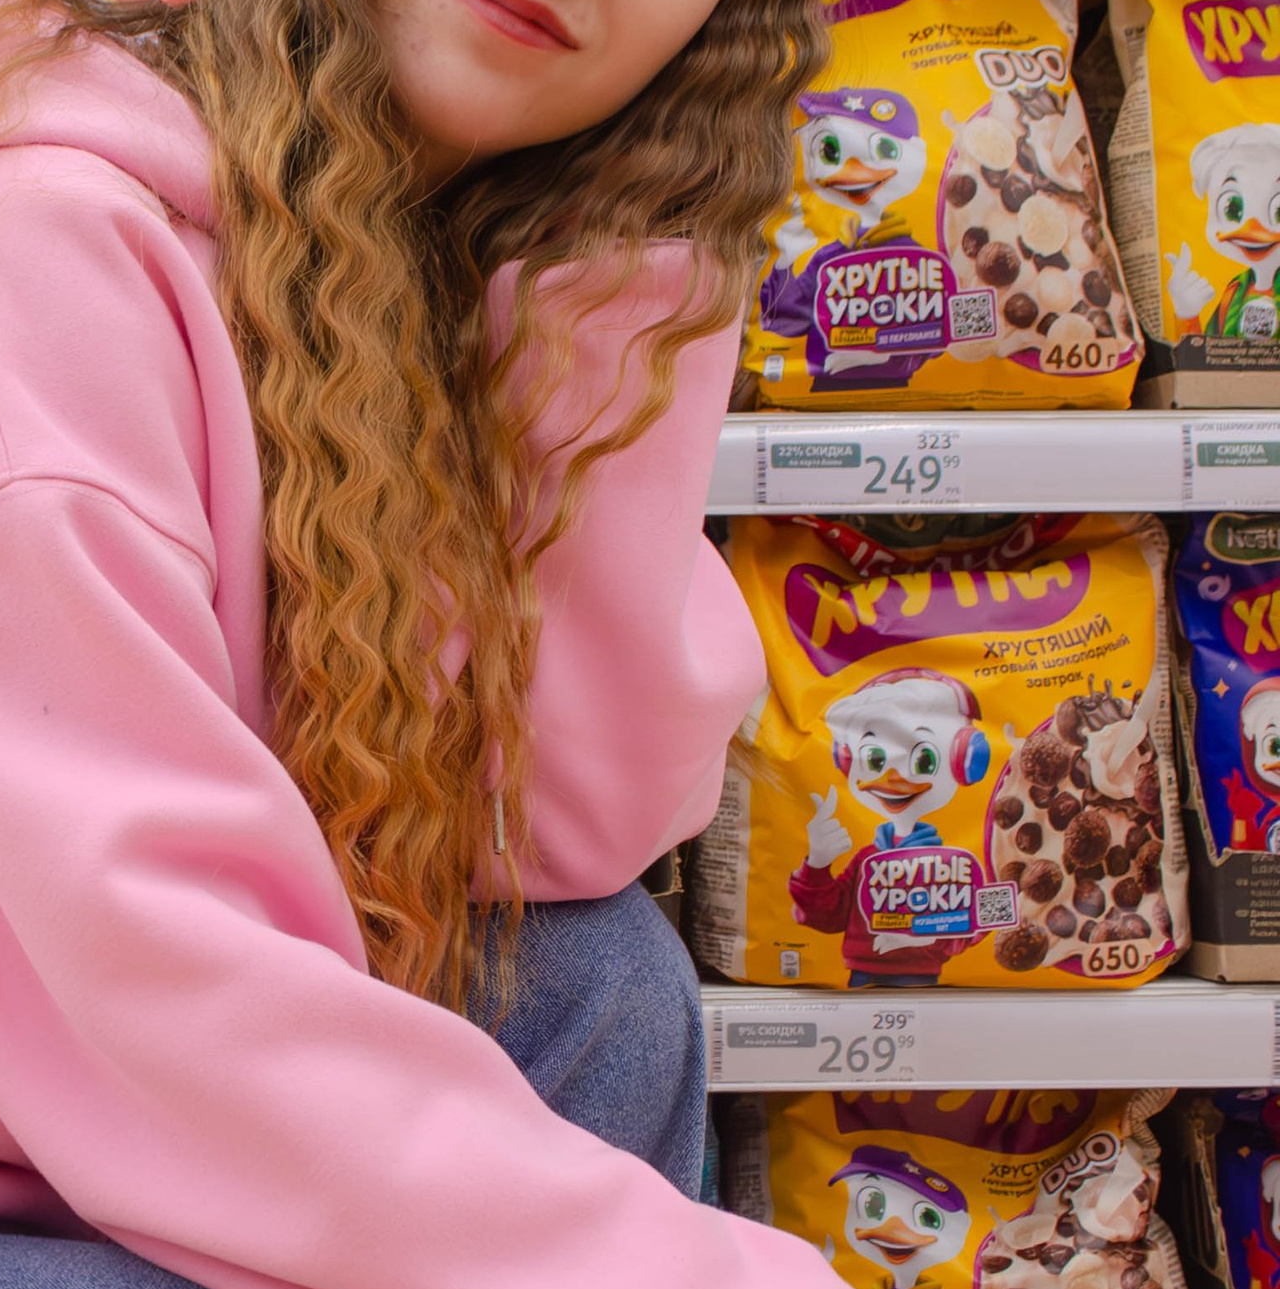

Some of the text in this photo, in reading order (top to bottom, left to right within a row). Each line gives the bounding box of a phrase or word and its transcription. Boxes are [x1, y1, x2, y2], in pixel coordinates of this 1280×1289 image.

[980, 49, 1066, 86] DUO
[825, 258, 943, 297] ХРУТЫЕ
[825, 291, 943, 325] УРОКИ
[1045, 343, 1100, 370] 460
[778, 434, 951, 457] 22% СКИДКА 323
[1217, 444, 1265, 456] СКИДКА
[864, 455, 960, 494] 249 99
[983, 613, 1112, 659] ХРУСТЯЩИЙ
[974, 634, 1130, 678] готовый шоколадный
[1026, 672, 1084, 689] завтрак
[869, 855, 972, 887] ХРУТЫЕ
[869, 884, 971, 912] УРОКИ
[1088, 943, 1140, 972] 650
[758, 1025, 805, 1038] СКИДКА
[873, 1014, 907, 1029] 299
[819, 1036, 896, 1073] 269
[898, 1035, 914, 1049] 99
[1042, 1133, 1116, 1194] DUO
